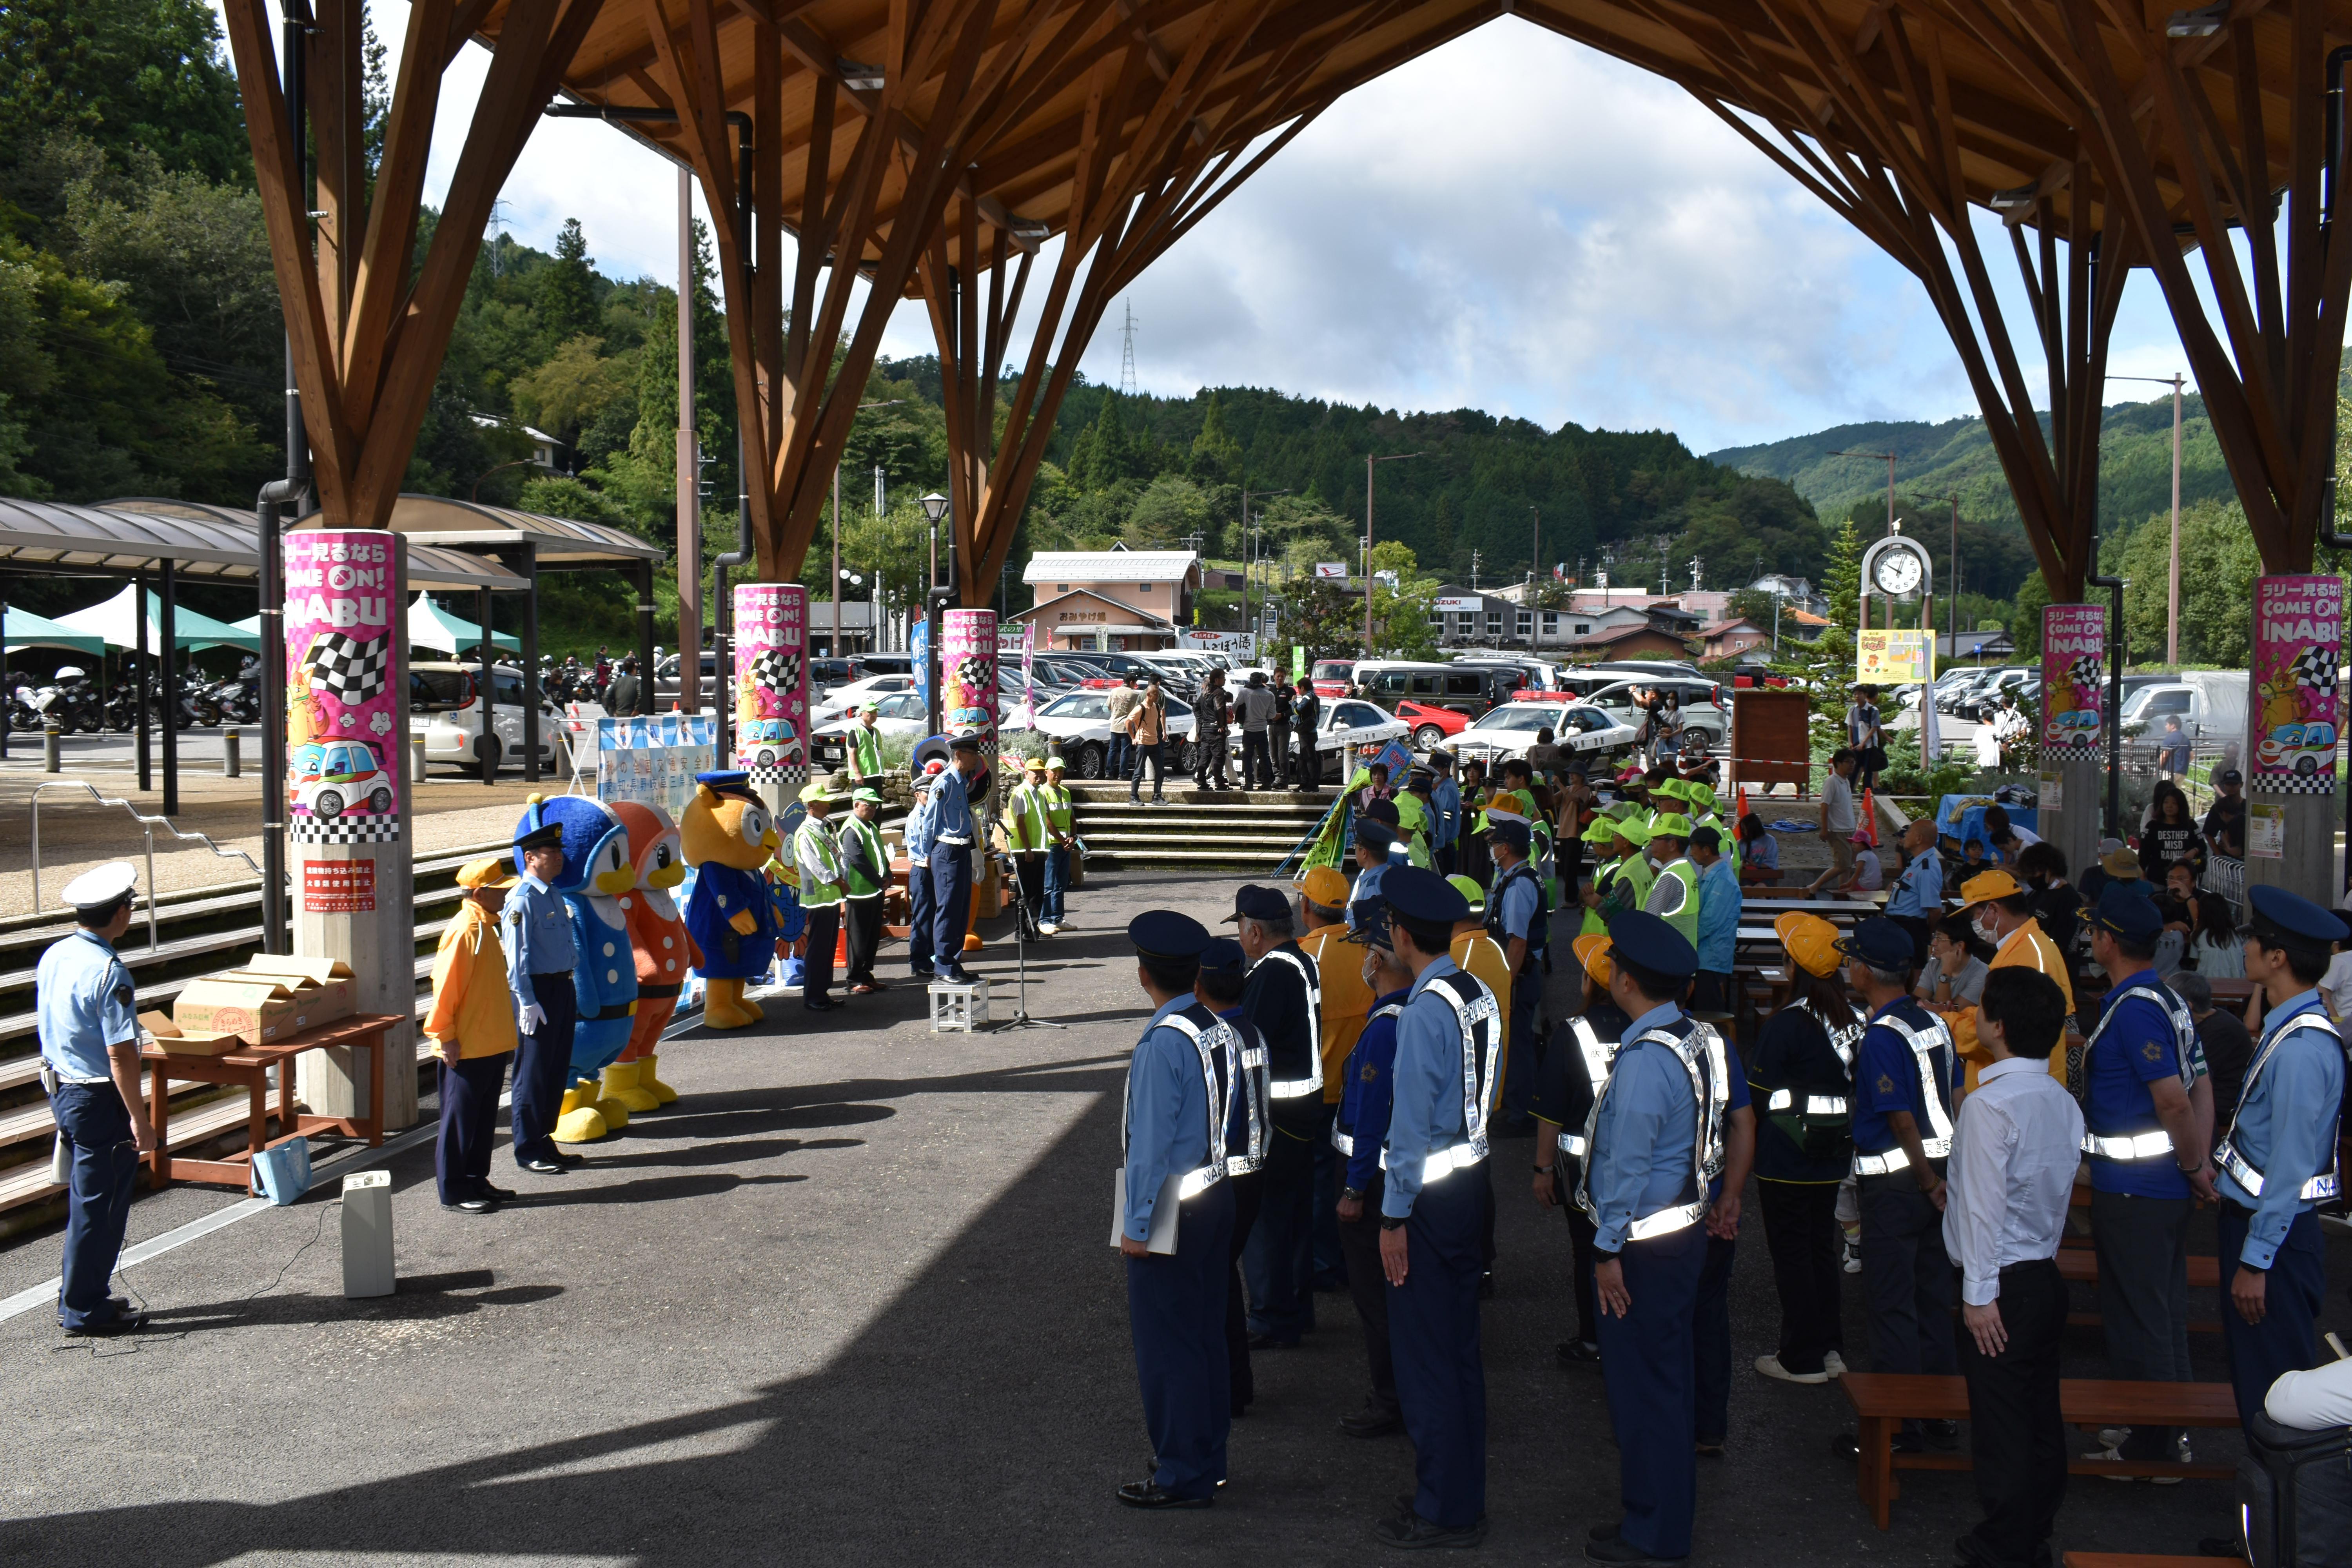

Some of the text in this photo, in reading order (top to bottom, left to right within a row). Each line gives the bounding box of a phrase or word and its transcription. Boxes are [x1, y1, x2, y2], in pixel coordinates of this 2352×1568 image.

[328, 564, 385, 591] ON!
[766, 607, 800, 624] ON!
[2262, 599, 2311, 618] COME
[969, 626, 992, 638] ON!
[2049, 622, 2082, 636] COME
[2263, 619, 2340, 643] INABU
[2049, 636, 2102, 654] INABU
[1336, 744, 1375, 760] PICE
[1601, 746, 1615, 754] POLICE
[1389, 750, 1406, 768] ENA
[2158, 830, 2189, 840] DESTHER
[2164, 840, 2183, 849] MISD
[1463, 997, 1494, 1025] POLICE
[221, 1016, 242, 1027] きらめき
[1200, 1025, 1229, 1049] POLICE
